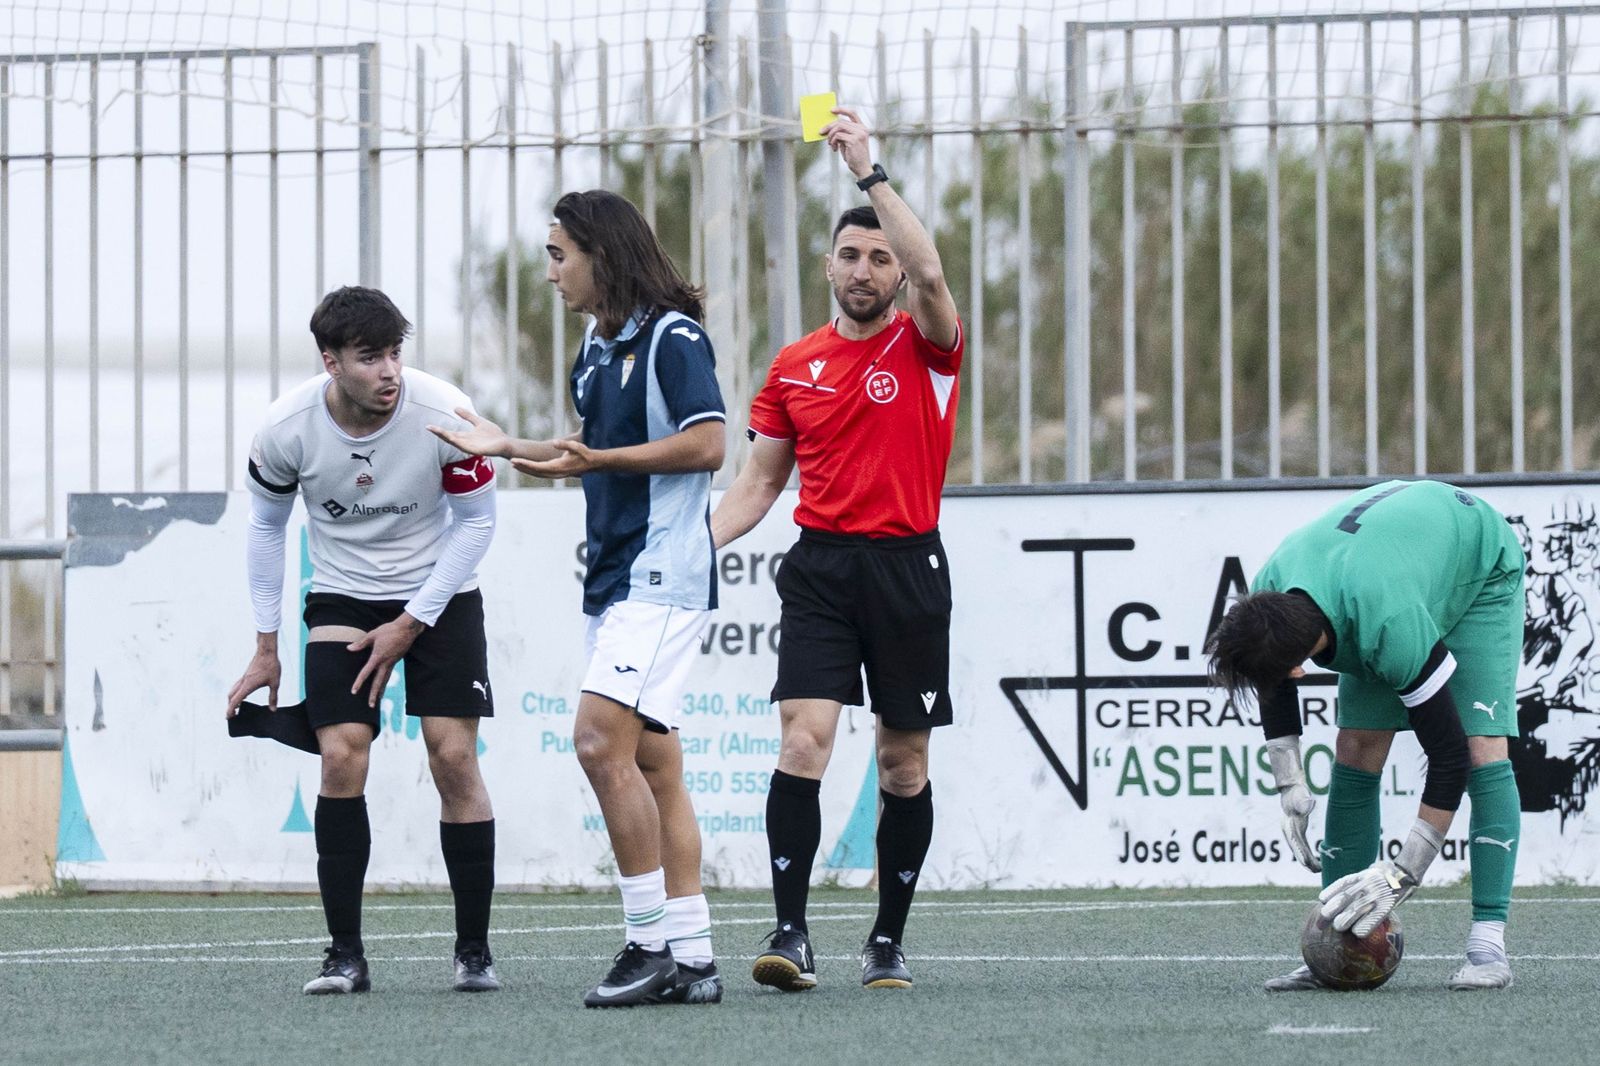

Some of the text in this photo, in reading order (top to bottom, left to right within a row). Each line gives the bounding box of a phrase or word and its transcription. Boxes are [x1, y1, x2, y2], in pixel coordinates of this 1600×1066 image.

[351, 502, 418, 516] Alprosan
[522, 691, 573, 714] Ctra.
[684, 771, 723, 793] 950
[1119, 829, 1180, 863] José
[1192, 827, 1281, 863] Carlos
